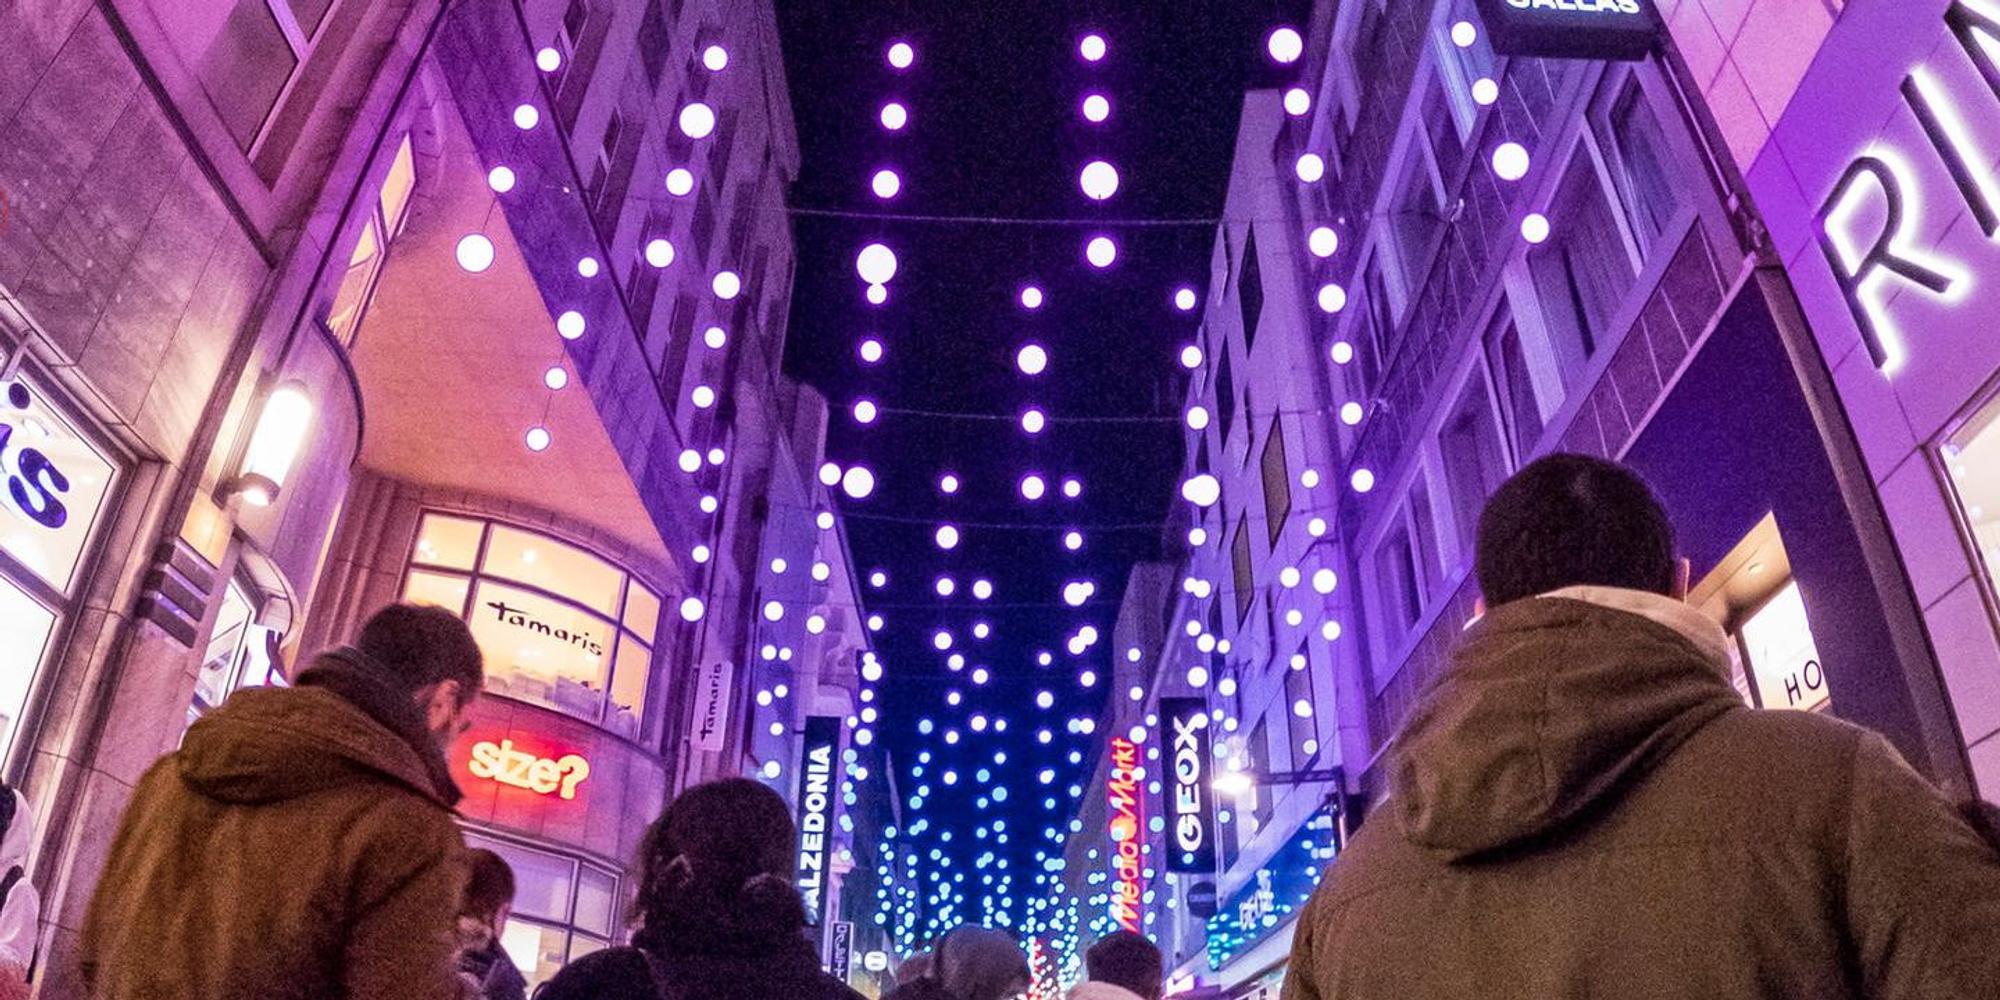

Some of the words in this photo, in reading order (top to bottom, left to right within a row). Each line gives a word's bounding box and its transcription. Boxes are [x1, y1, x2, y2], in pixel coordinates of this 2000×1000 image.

[487, 601, 603, 657] tamaris
[700, 663, 723, 742] tamaris
[468, 739, 590, 800] size?
[1173, 714, 1203, 852] GEOX
